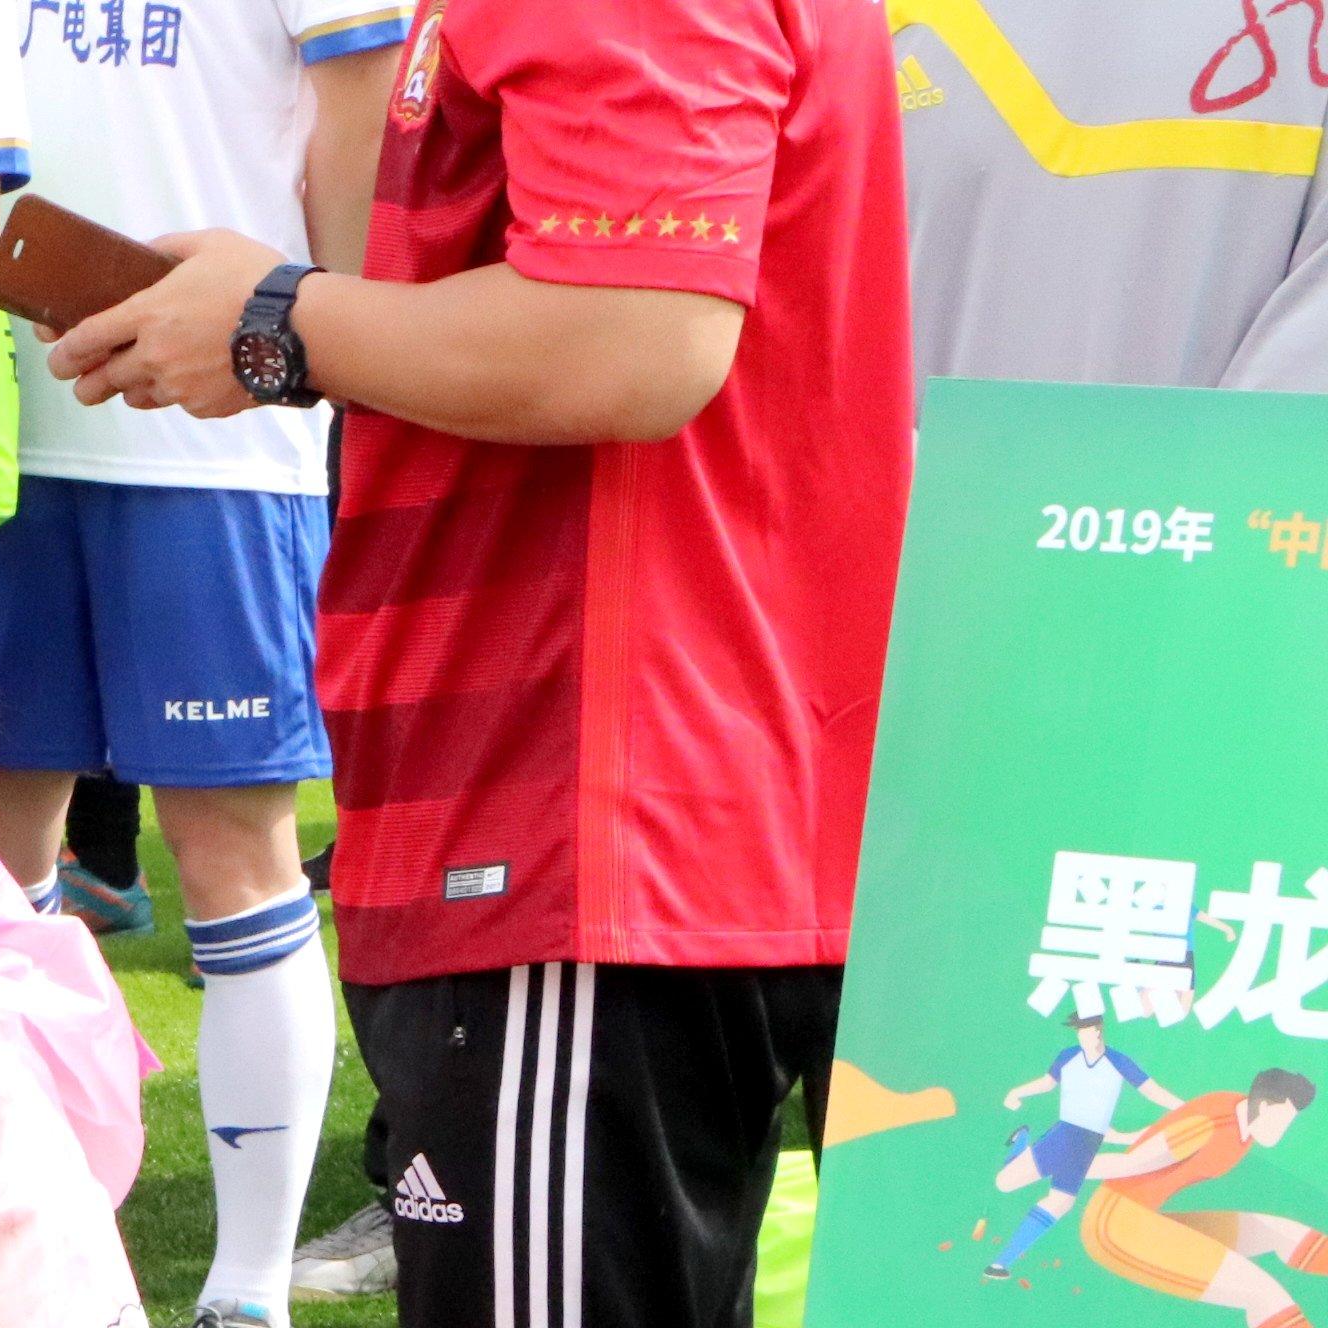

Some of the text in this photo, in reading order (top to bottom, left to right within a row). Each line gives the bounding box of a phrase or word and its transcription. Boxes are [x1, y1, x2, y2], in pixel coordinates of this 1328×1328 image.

[1036, 503, 1328, 571] 2019年 “中
[165, 697, 271, 721] KELME
[1026, 850, 1328, 1039] 黑龙
[394, 1194, 465, 1223] adidas
